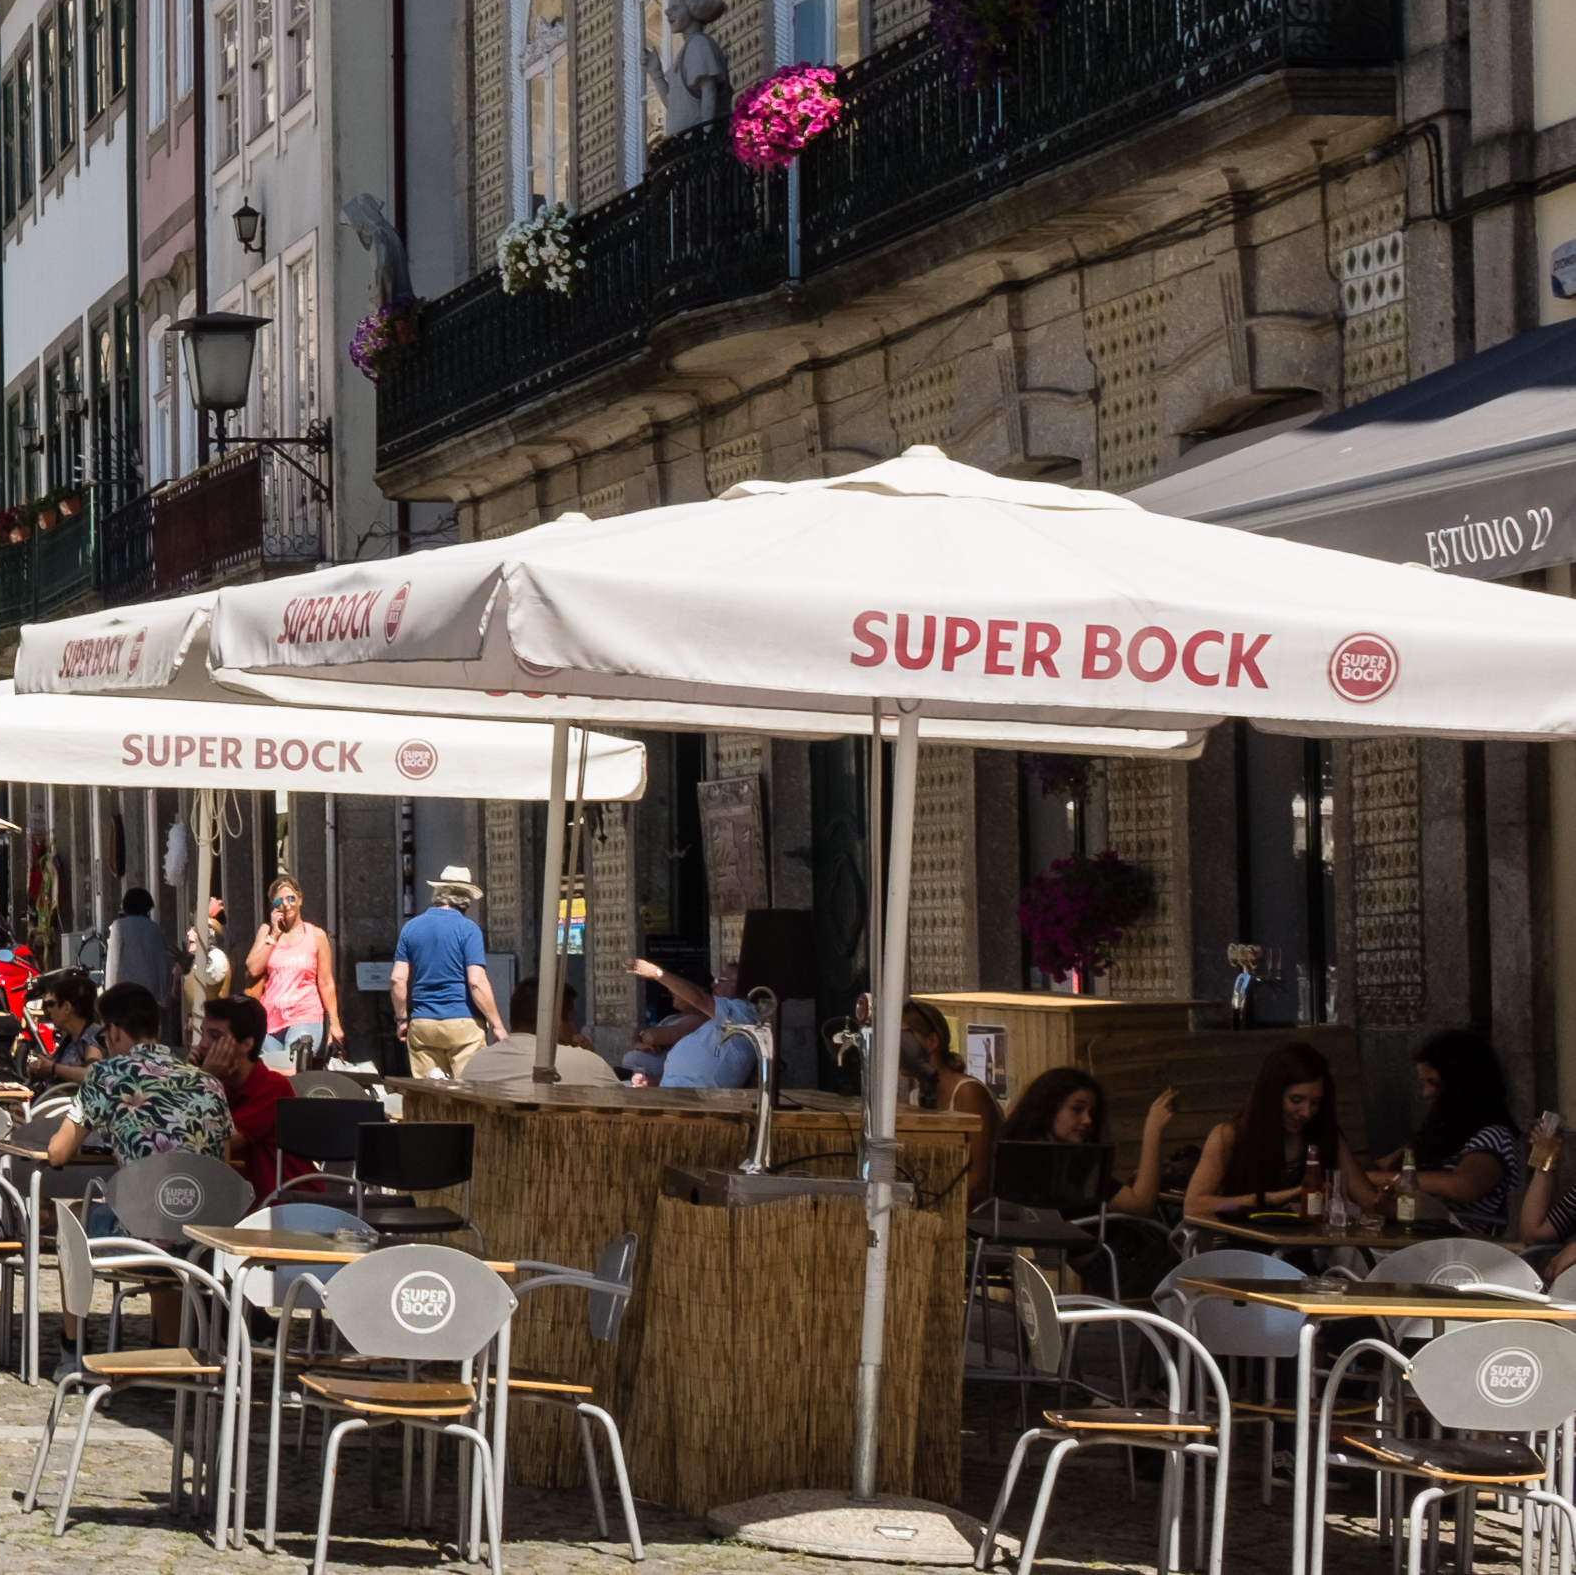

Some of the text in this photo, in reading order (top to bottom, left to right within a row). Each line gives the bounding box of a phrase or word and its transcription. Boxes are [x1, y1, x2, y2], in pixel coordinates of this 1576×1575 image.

[1425, 507, 1553, 569] ESTÚDIO 22
[277, 589, 384, 645] SUPER BOCK
[850, 610, 1273, 689] SUPER BOCK
[1340, 653, 1388, 669] SUPER
[1341, 667, 1384, 682] BOCK
[121, 733, 364, 773] SUPER BOCK
[402, 749, 431, 760] SUPER
[403, 758, 430, 769] BOCK
[164, 1187, 196, 1198] SUPER
[165, 1196, 194, 1206] BOCK
[400, 1287, 448, 1304] SUPER
[401, 1300, 444, 1317] BOCK
[1489, 1364, 1532, 1378] SUPER
[1489, 1376, 1528, 1388] BOCK
